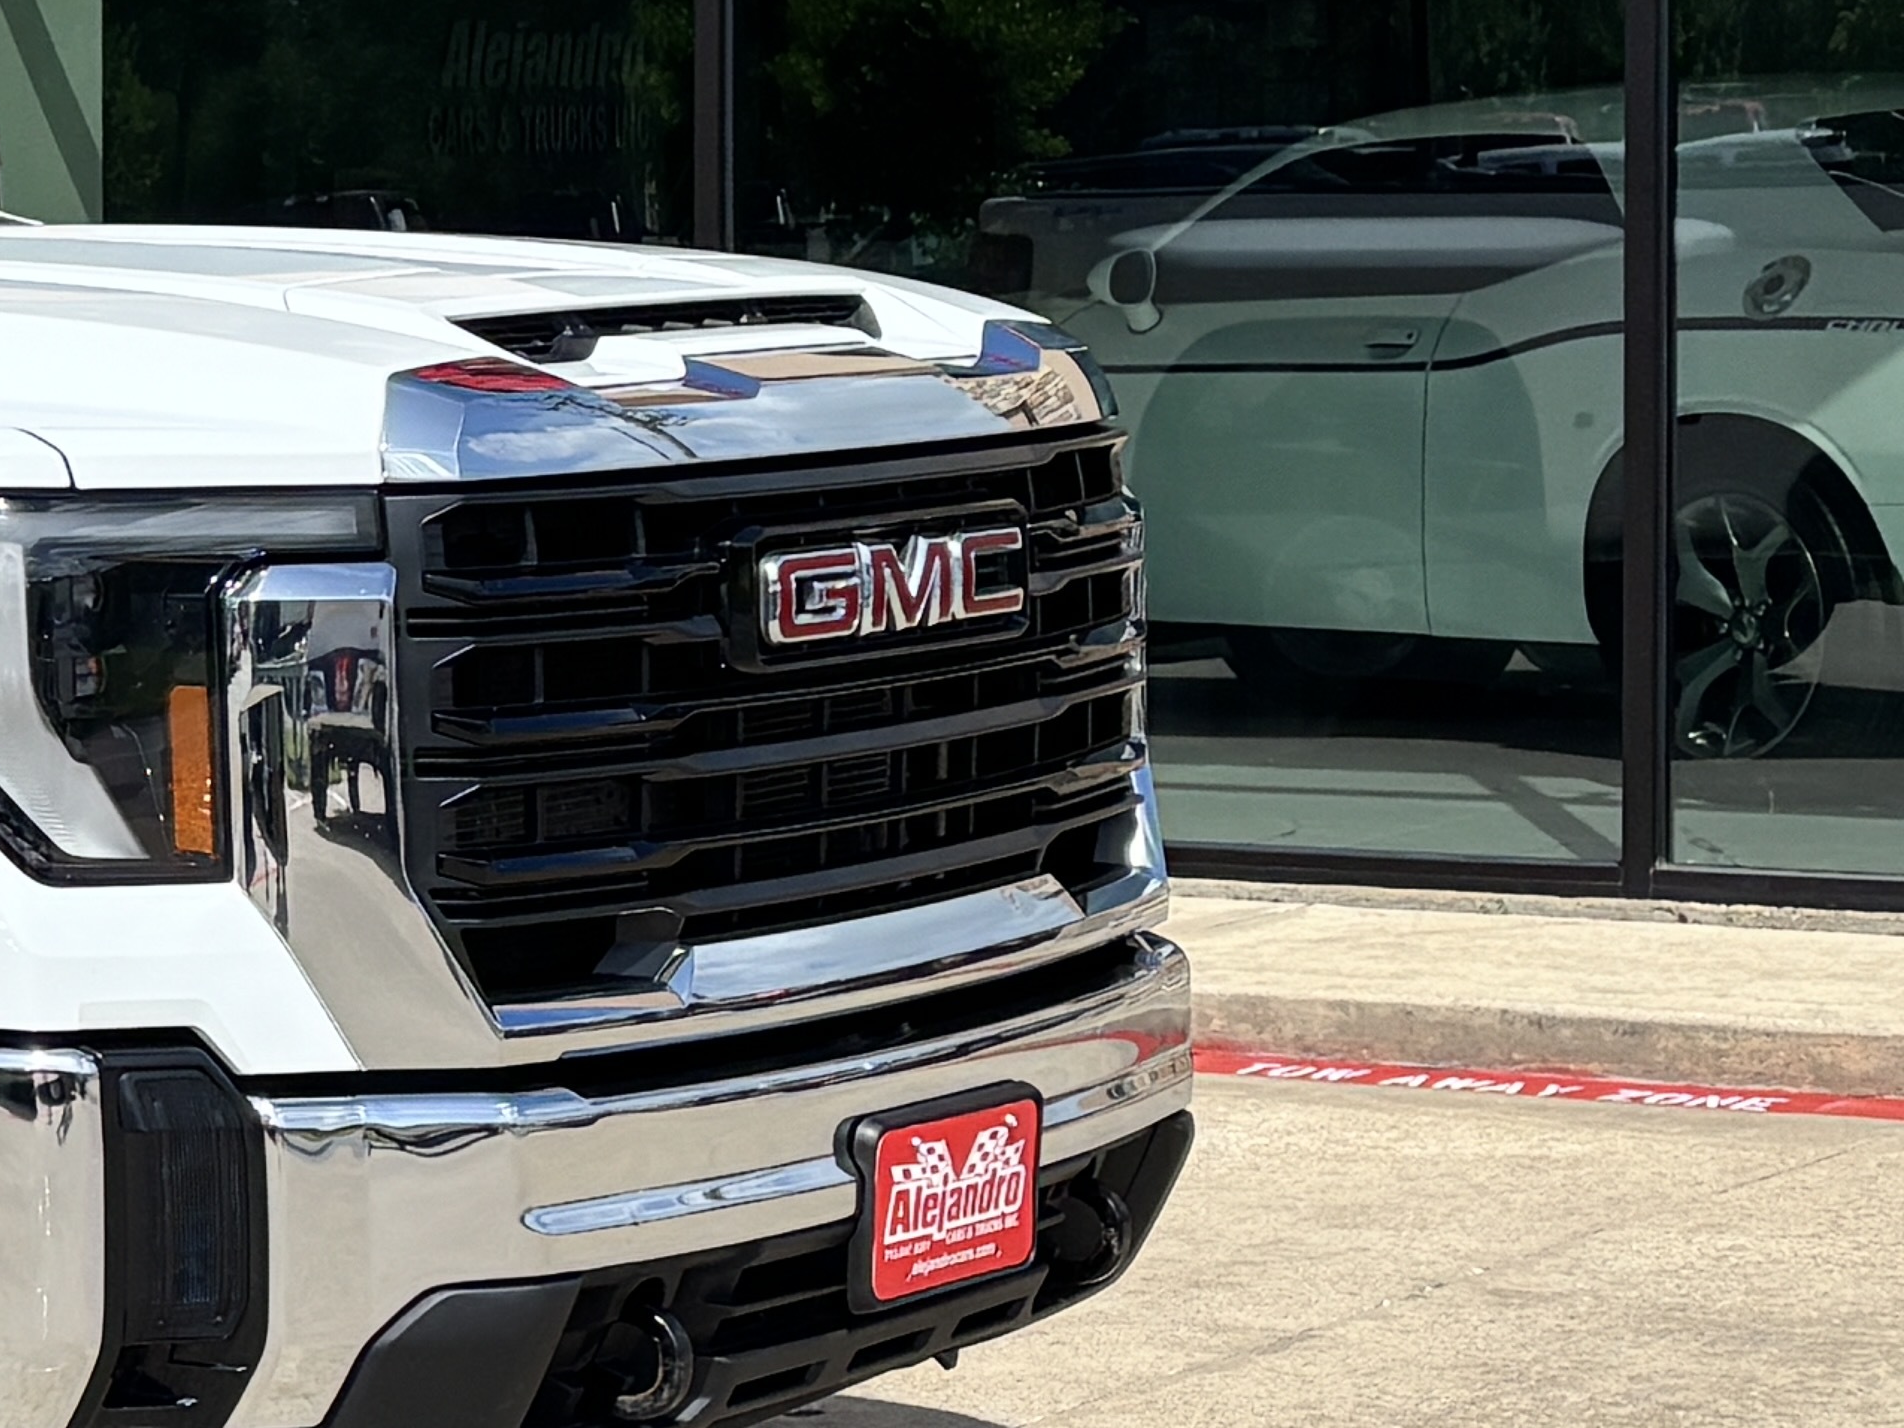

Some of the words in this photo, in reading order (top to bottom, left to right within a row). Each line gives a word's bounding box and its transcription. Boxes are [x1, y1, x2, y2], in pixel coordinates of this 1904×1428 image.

[441, 19, 647, 93] Alejandro
[428, 104, 489, 154] CARS
[520, 102, 608, 154] TRUCKS
[760, 527, 1026, 646] GMC
[1236, 1061, 1373, 1081] TOW
[1380, 1072, 1585, 1098] AWAY
[1598, 1086, 1790, 1113] ZONE
[884, 1163, 1026, 1242] Alejandro
